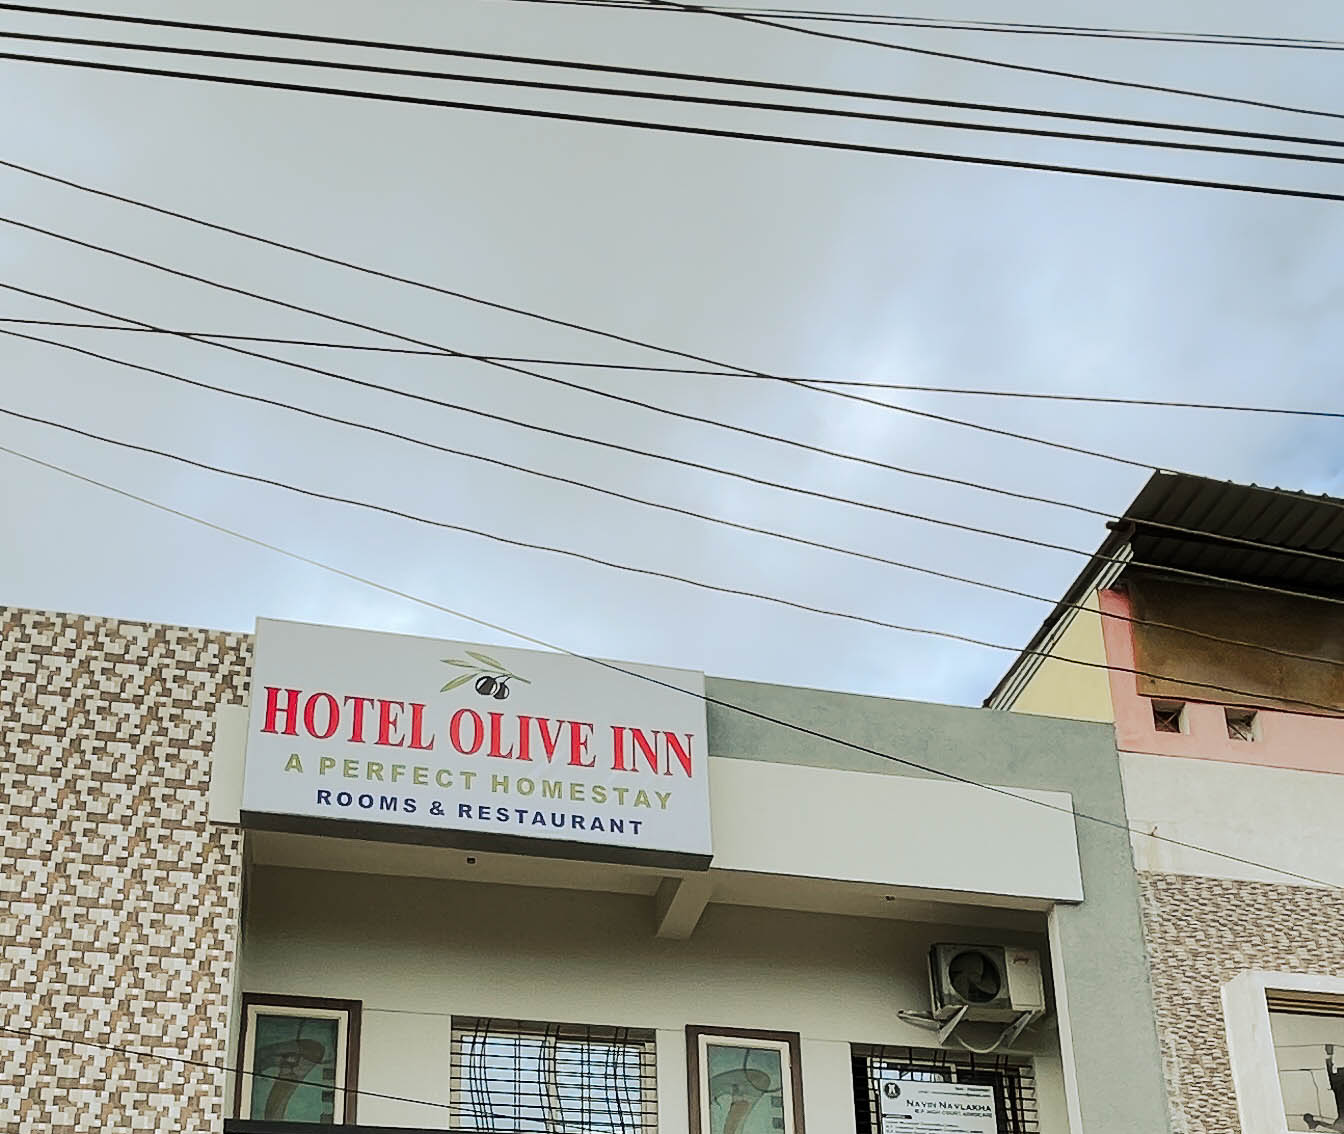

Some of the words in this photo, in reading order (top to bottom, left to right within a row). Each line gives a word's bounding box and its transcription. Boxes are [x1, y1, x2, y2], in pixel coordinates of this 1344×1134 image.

[260, 686, 435, 750] HOTEL
[449, 708, 596, 768] OLIVE
[610, 725, 695, 778] INN
[284, 753, 304, 773] A
[319, 756, 477, 790] PERFECT
[492, 774, 672, 810] HOMESTAY
[317, 789, 417, 813] ROOMS
[429, 801, 445, 816] &
[458, 803, 643, 835] RESTAURANT
